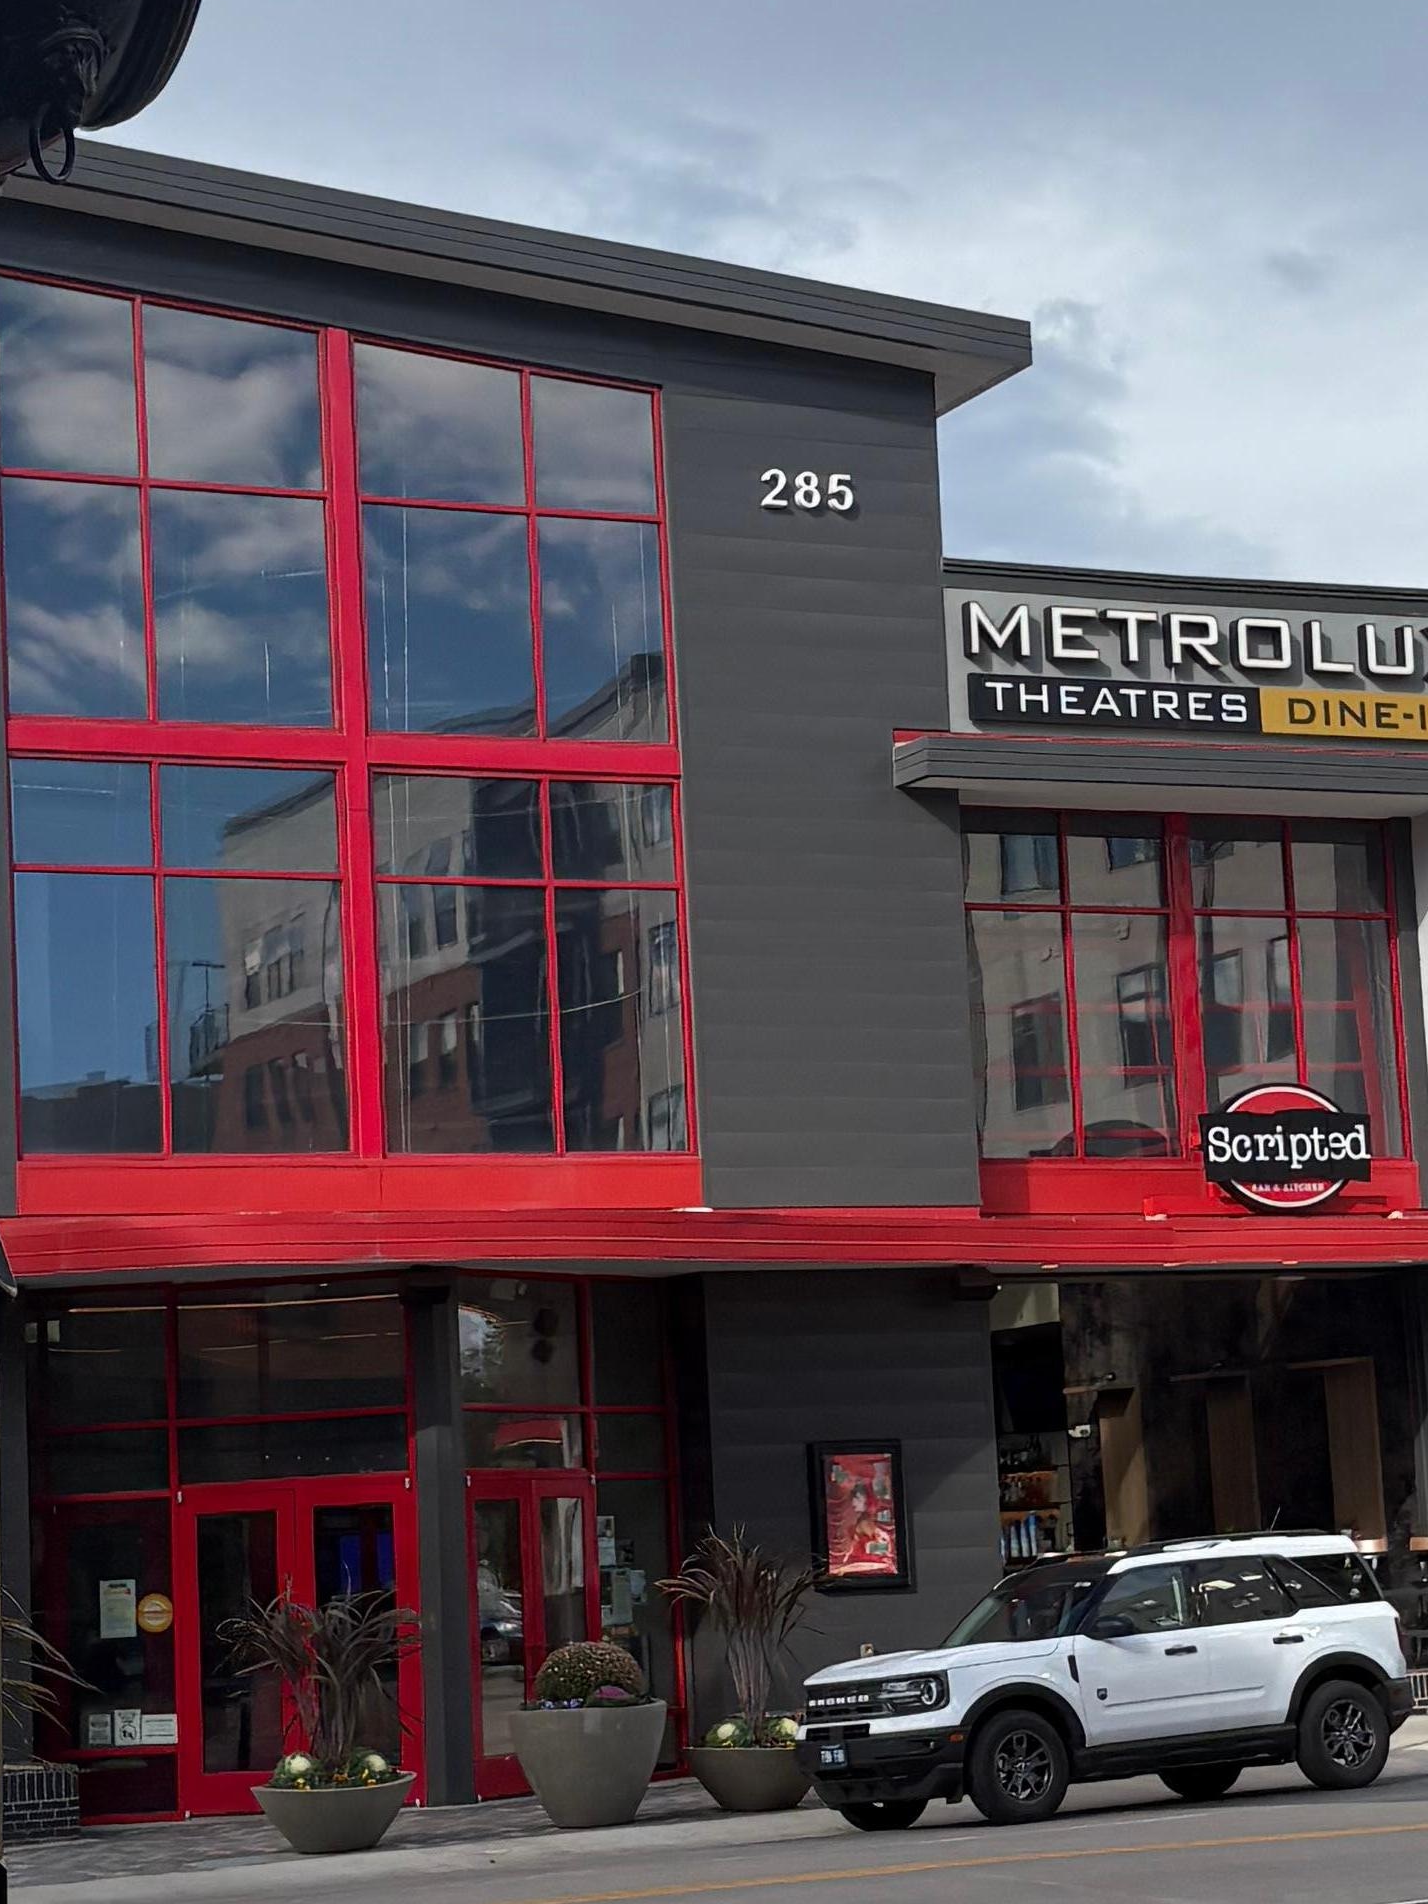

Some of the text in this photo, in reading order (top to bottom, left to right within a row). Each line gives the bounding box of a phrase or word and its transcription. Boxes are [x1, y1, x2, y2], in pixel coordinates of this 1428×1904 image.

[760, 467, 854, 511] 285
[984, 681, 1248, 723] THEATRES
[1207, 1124, 1372, 1170] Scripted
